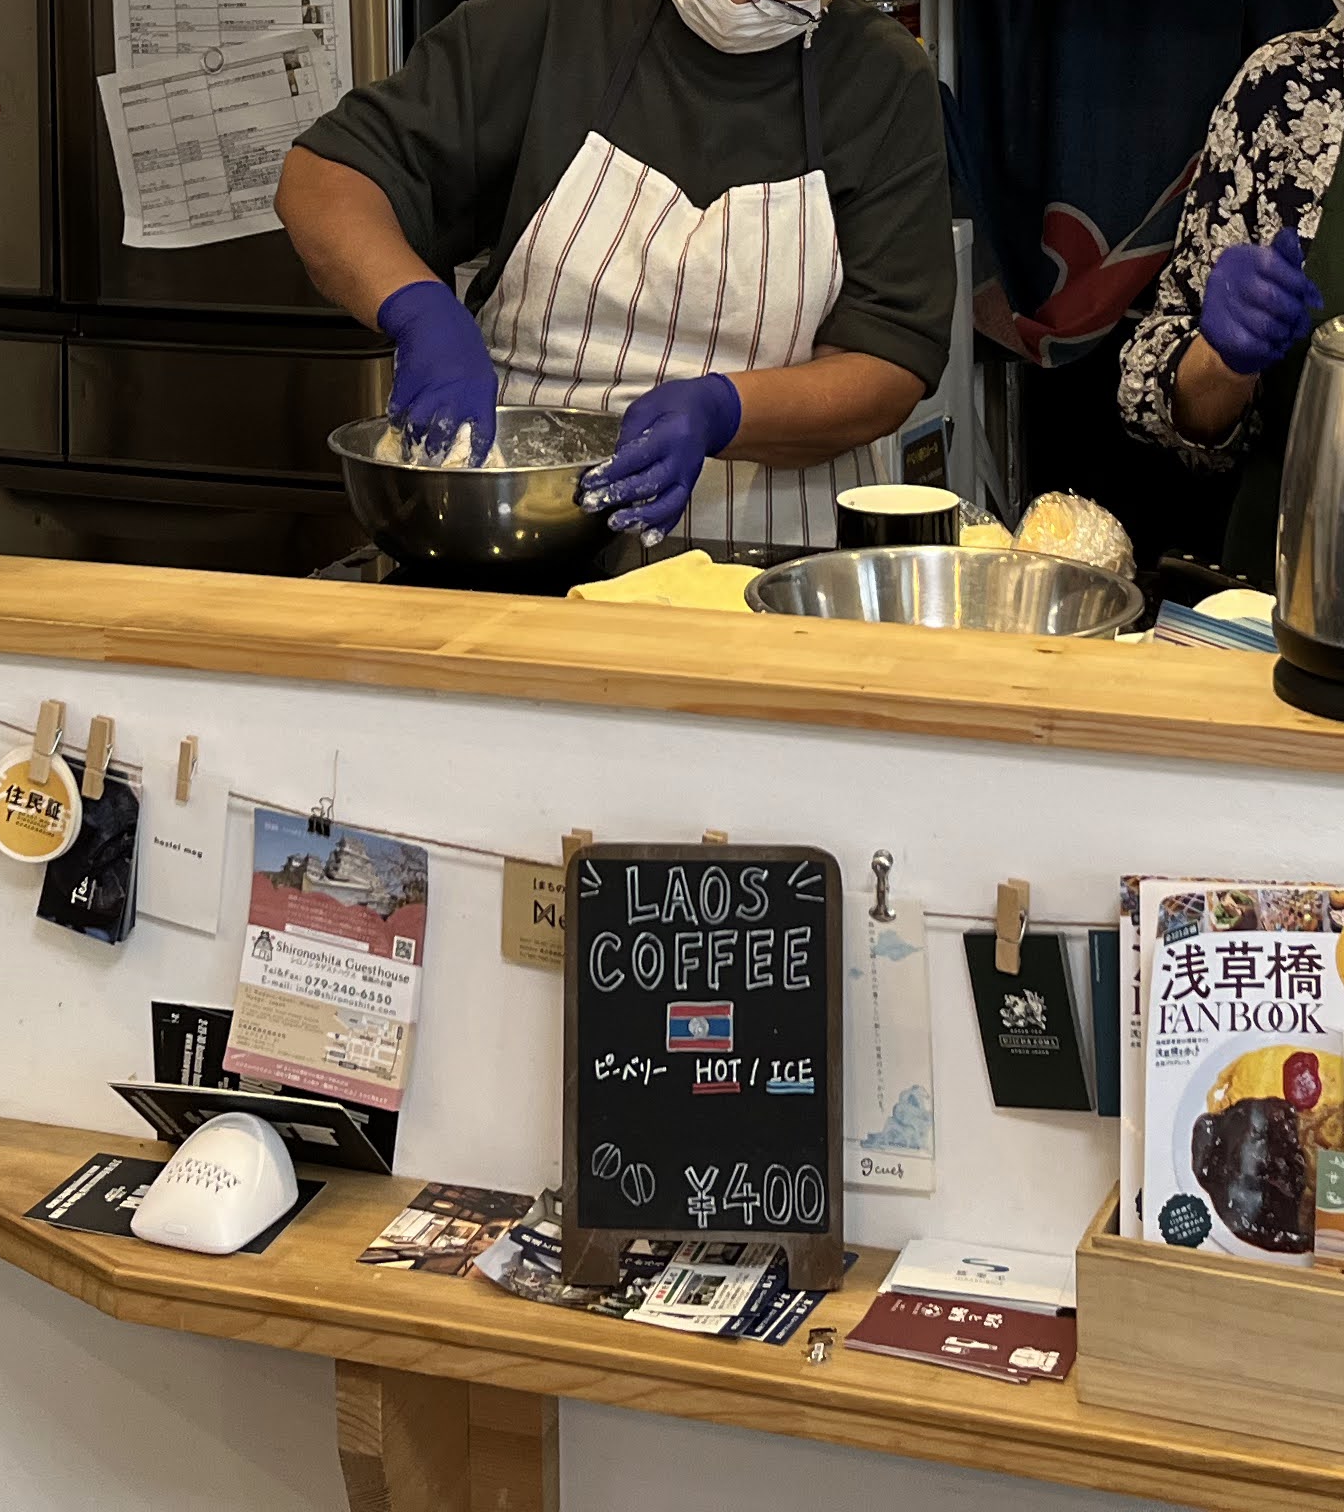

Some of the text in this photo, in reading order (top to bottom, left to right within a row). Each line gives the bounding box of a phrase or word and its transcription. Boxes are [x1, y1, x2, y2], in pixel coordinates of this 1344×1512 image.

[625, 865, 769, 926] LAOS
[589, 927, 812, 991] COFFEE
[1161, 940, 1326, 1001] 浅草橋
[594, 1053, 668, 1086] ピーベリー
[696, 1059, 743, 1083] HOT
[769, 1059, 814, 1083] ICE
[684, 1161, 825, 1229] ¥400
